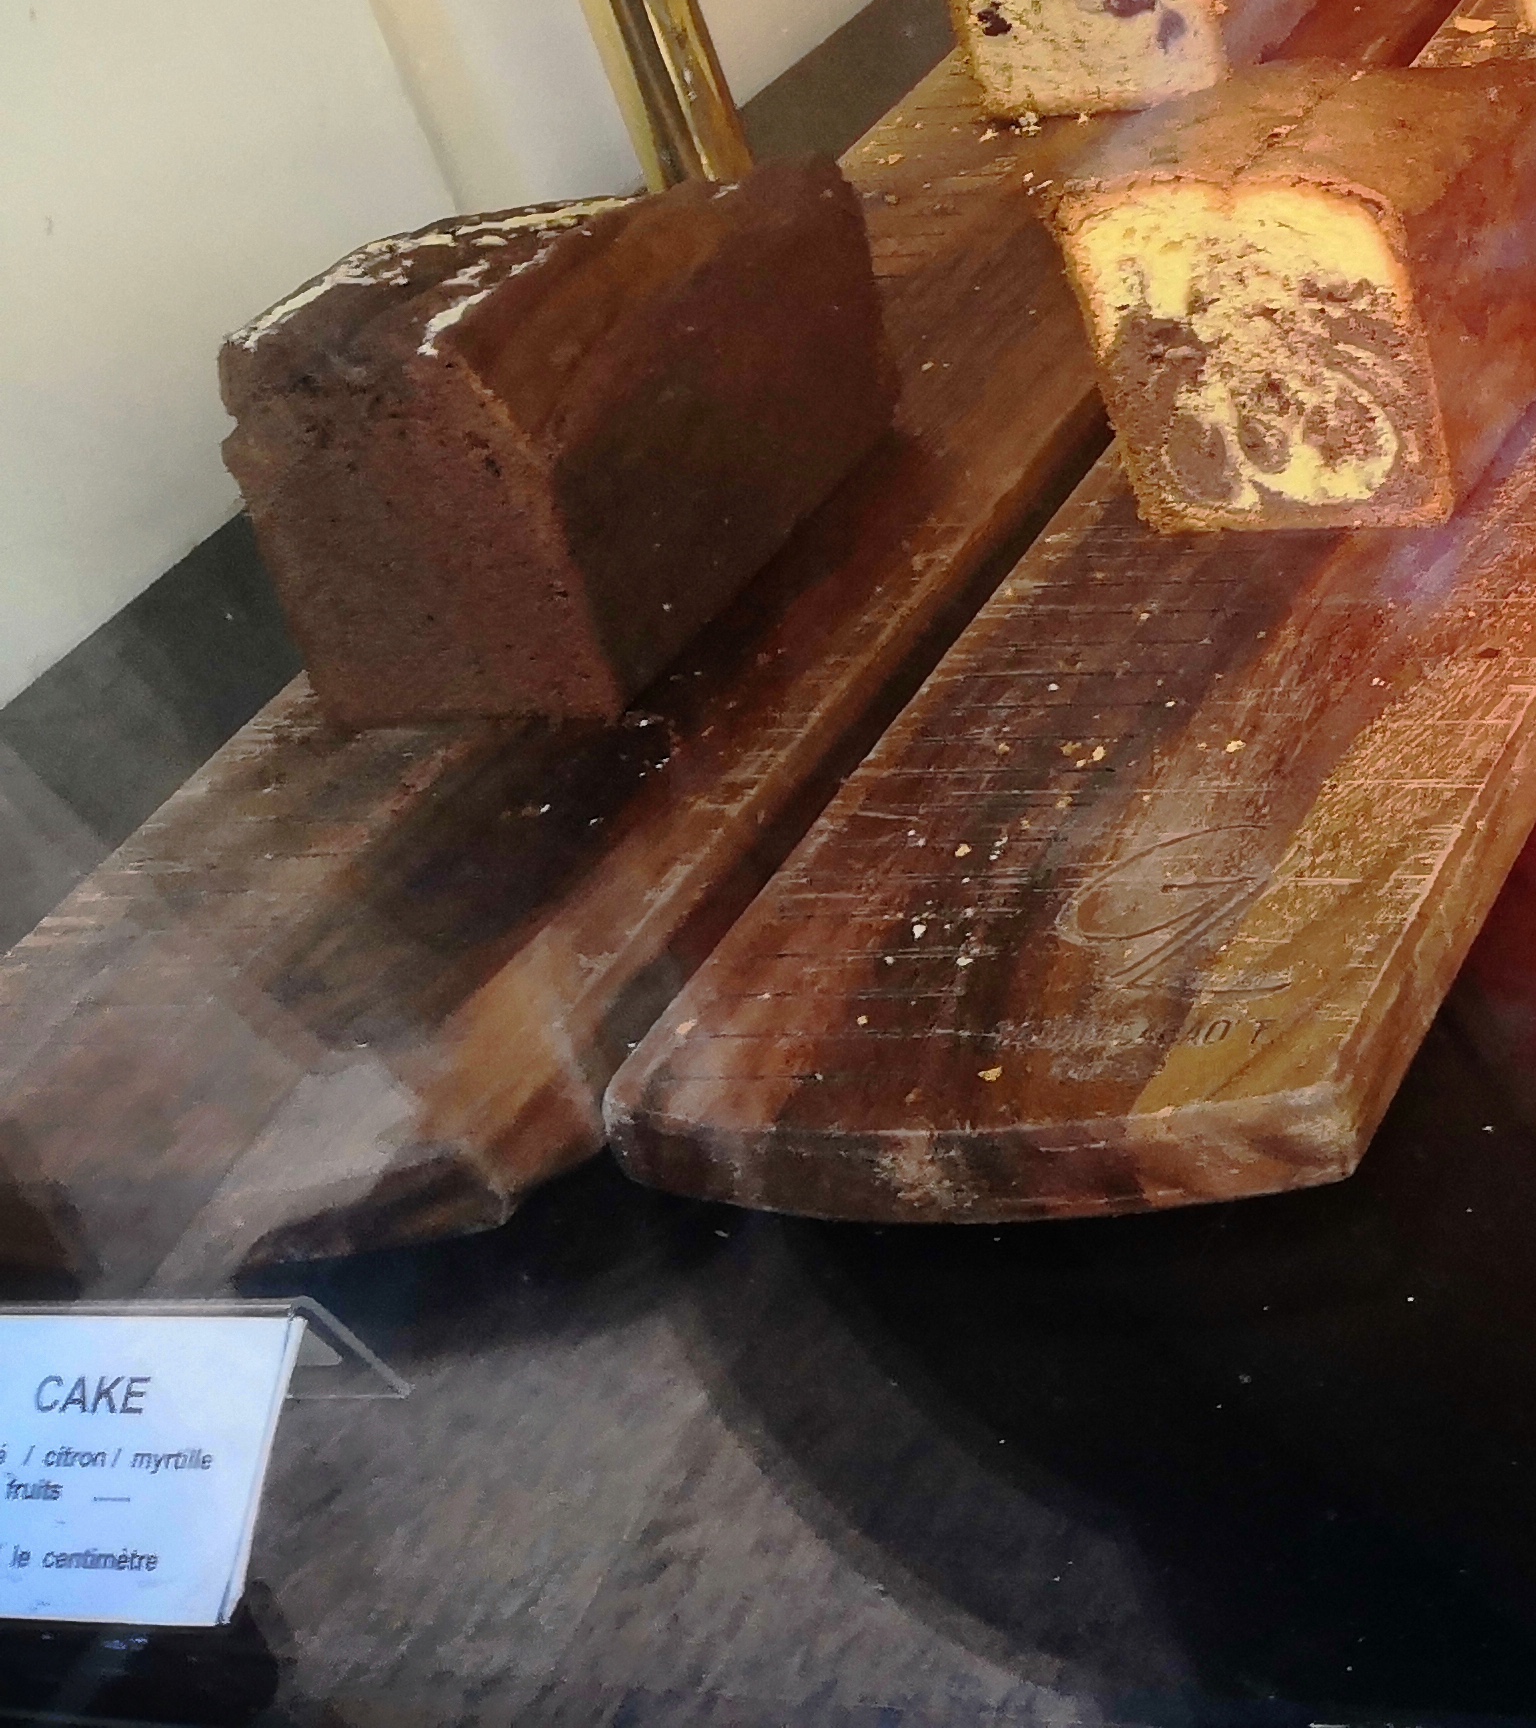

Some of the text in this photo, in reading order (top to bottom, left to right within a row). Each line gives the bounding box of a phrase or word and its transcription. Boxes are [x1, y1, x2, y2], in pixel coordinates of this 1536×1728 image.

[35, 1375, 152, 1415] CAKE
[131, 1447, 214, 1474] myrtille
[6, 1479, 63, 1501] fruits
[9, 1544, 31, 1568] le
